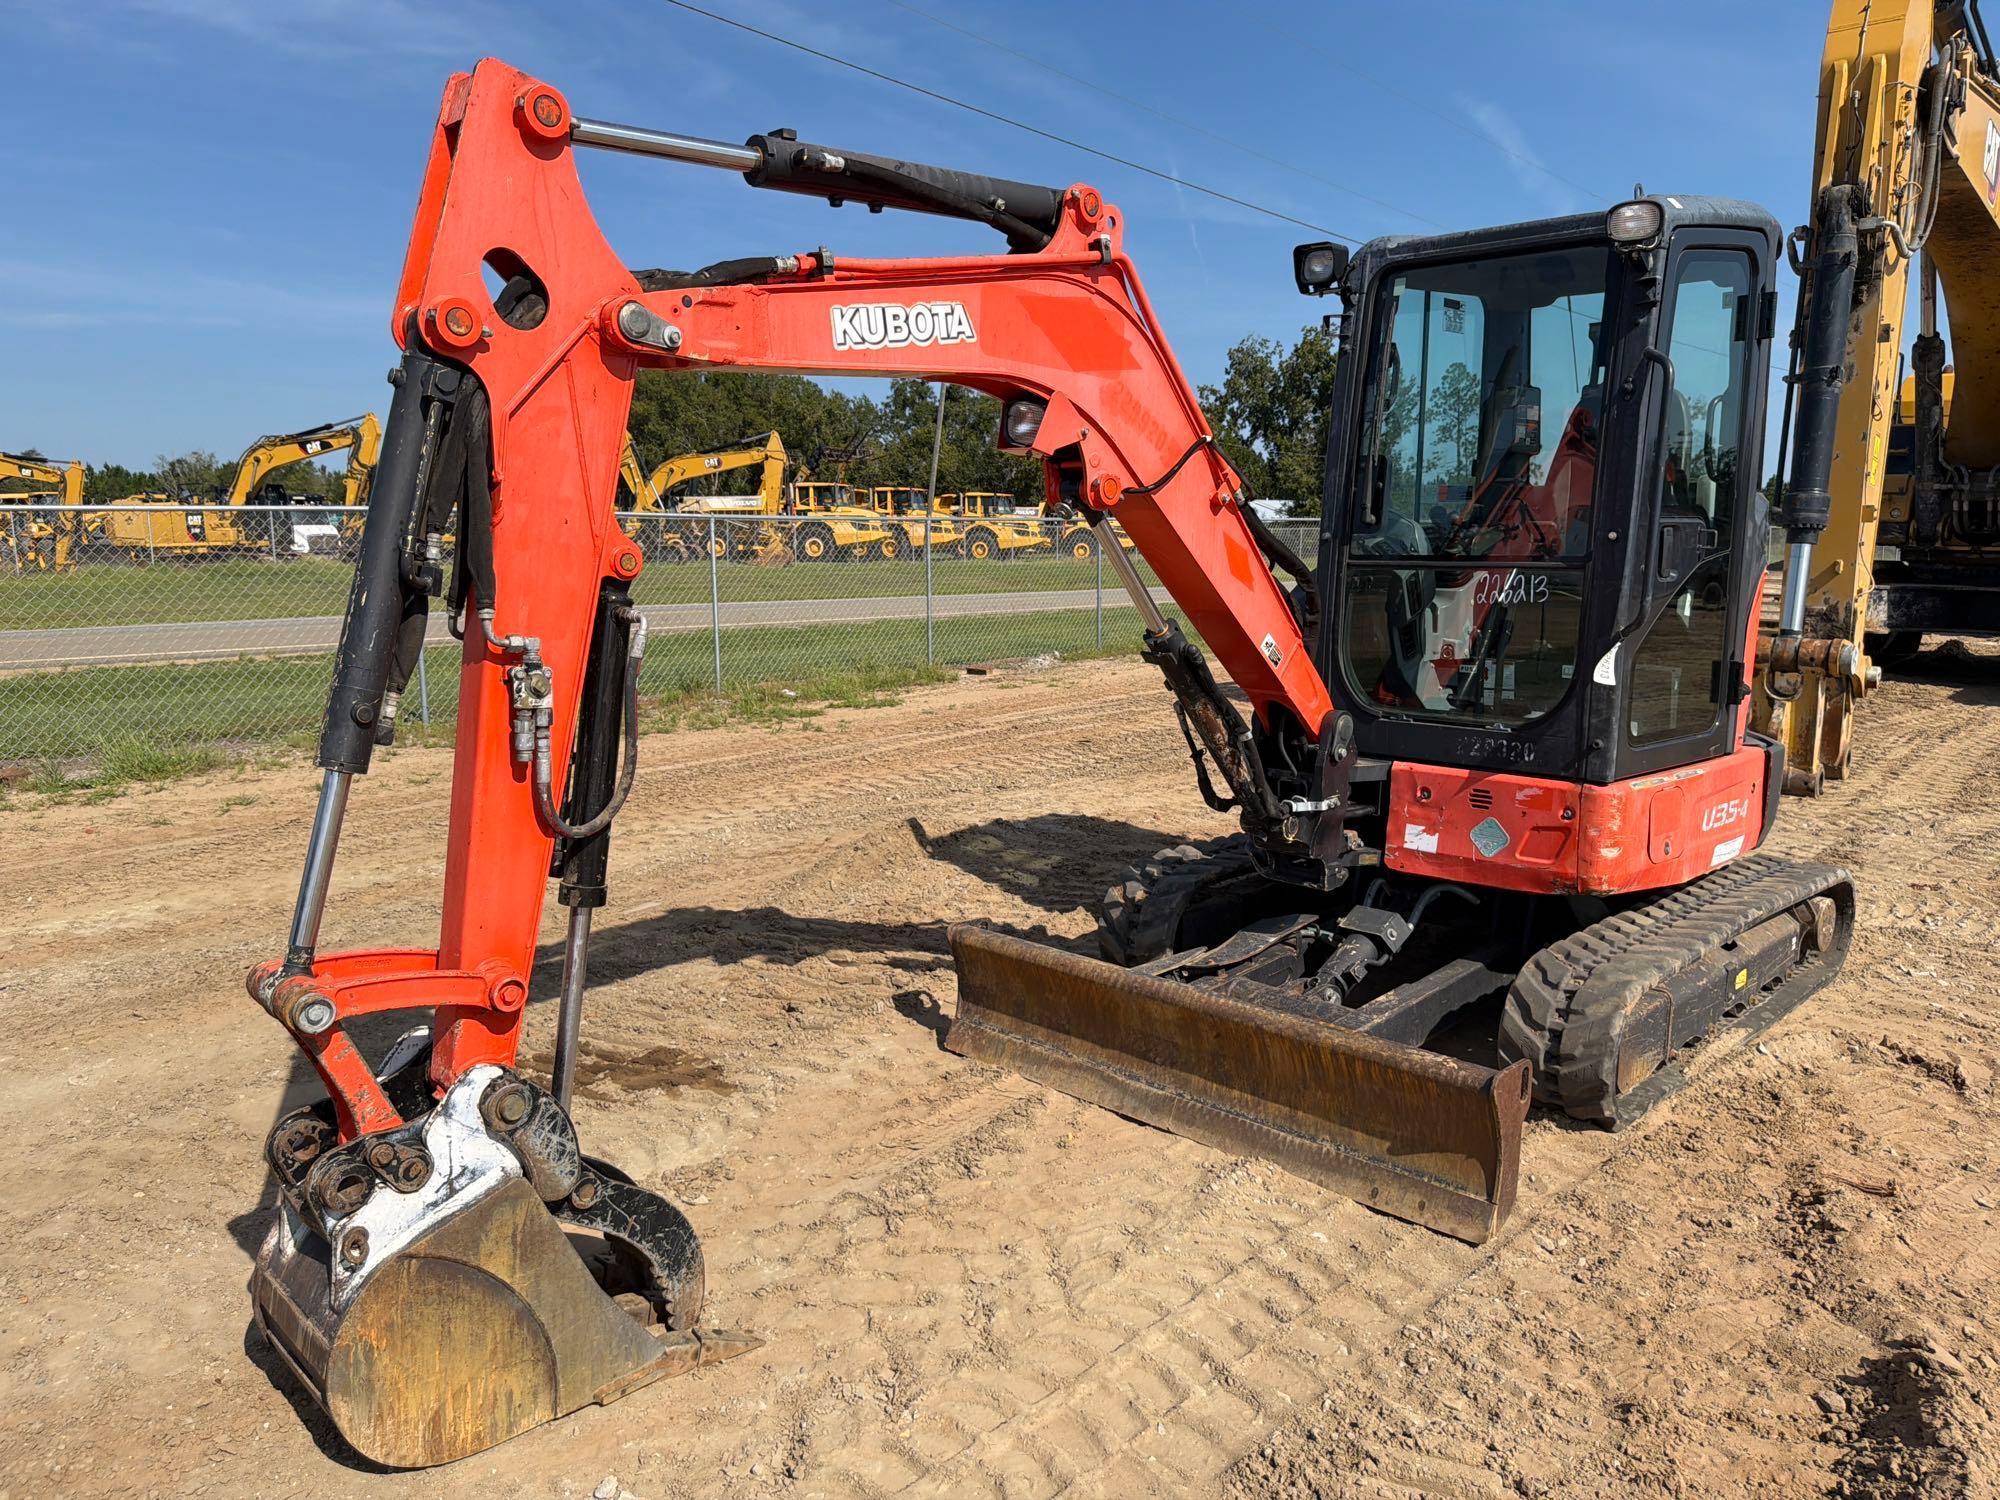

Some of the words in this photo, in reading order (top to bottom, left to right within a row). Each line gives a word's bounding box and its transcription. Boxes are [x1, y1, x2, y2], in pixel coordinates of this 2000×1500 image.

[831, 303, 976, 349] KUBOTA
[306, 440, 321, 454] CAT
[705, 458, 719, 468] CAT
[188, 515, 202, 525] CAT
[1476, 573, 1549, 605] 226213
[1701, 799, 1749, 831] U35-4
